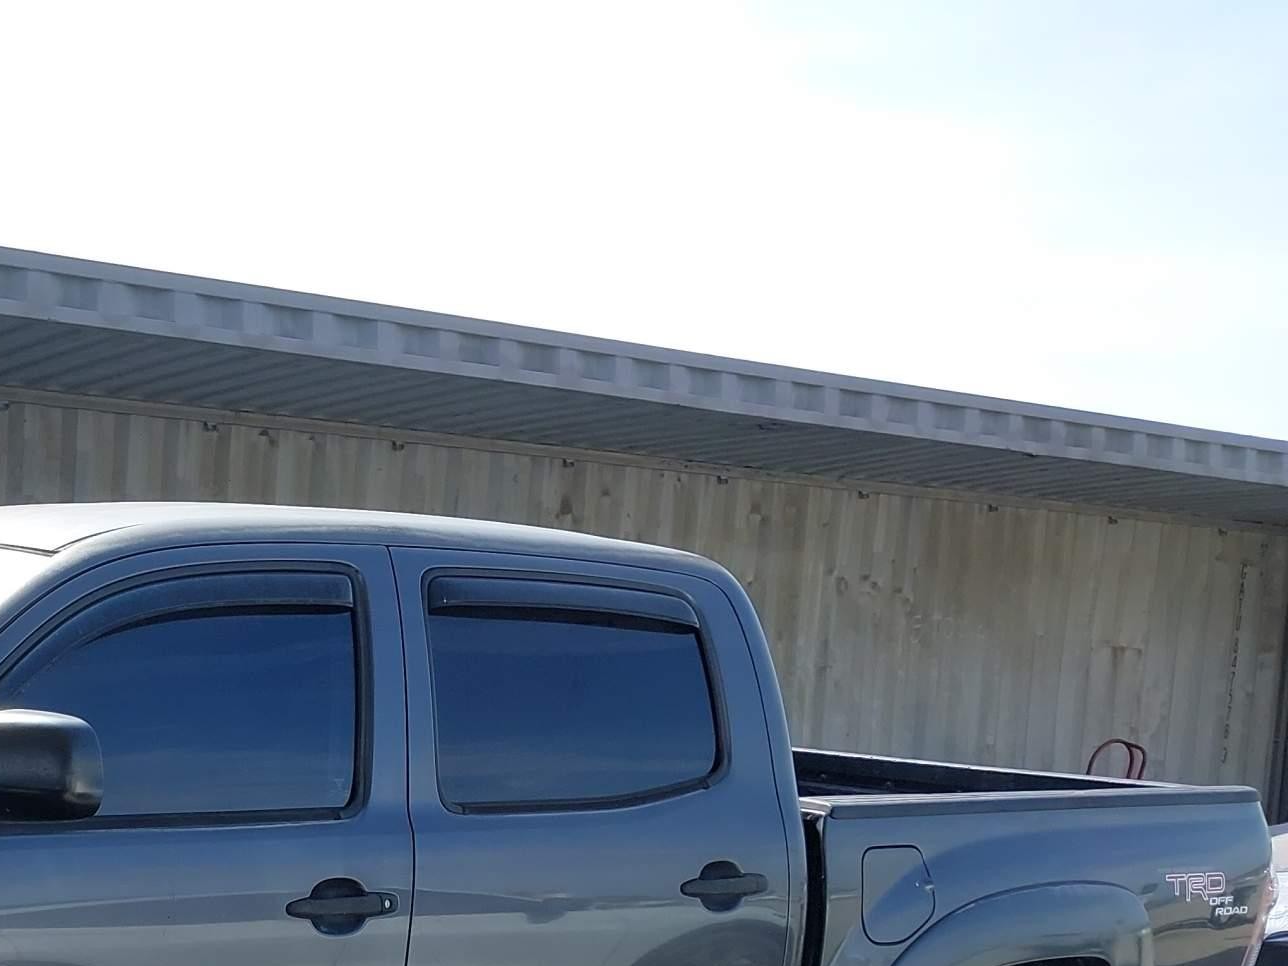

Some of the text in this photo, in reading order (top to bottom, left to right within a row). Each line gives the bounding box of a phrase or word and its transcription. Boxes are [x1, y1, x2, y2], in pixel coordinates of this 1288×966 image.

[1165, 872, 1226, 902] TRD
[1209, 896, 1235, 906] OFF
[1215, 906, 1249, 916] ROAD
